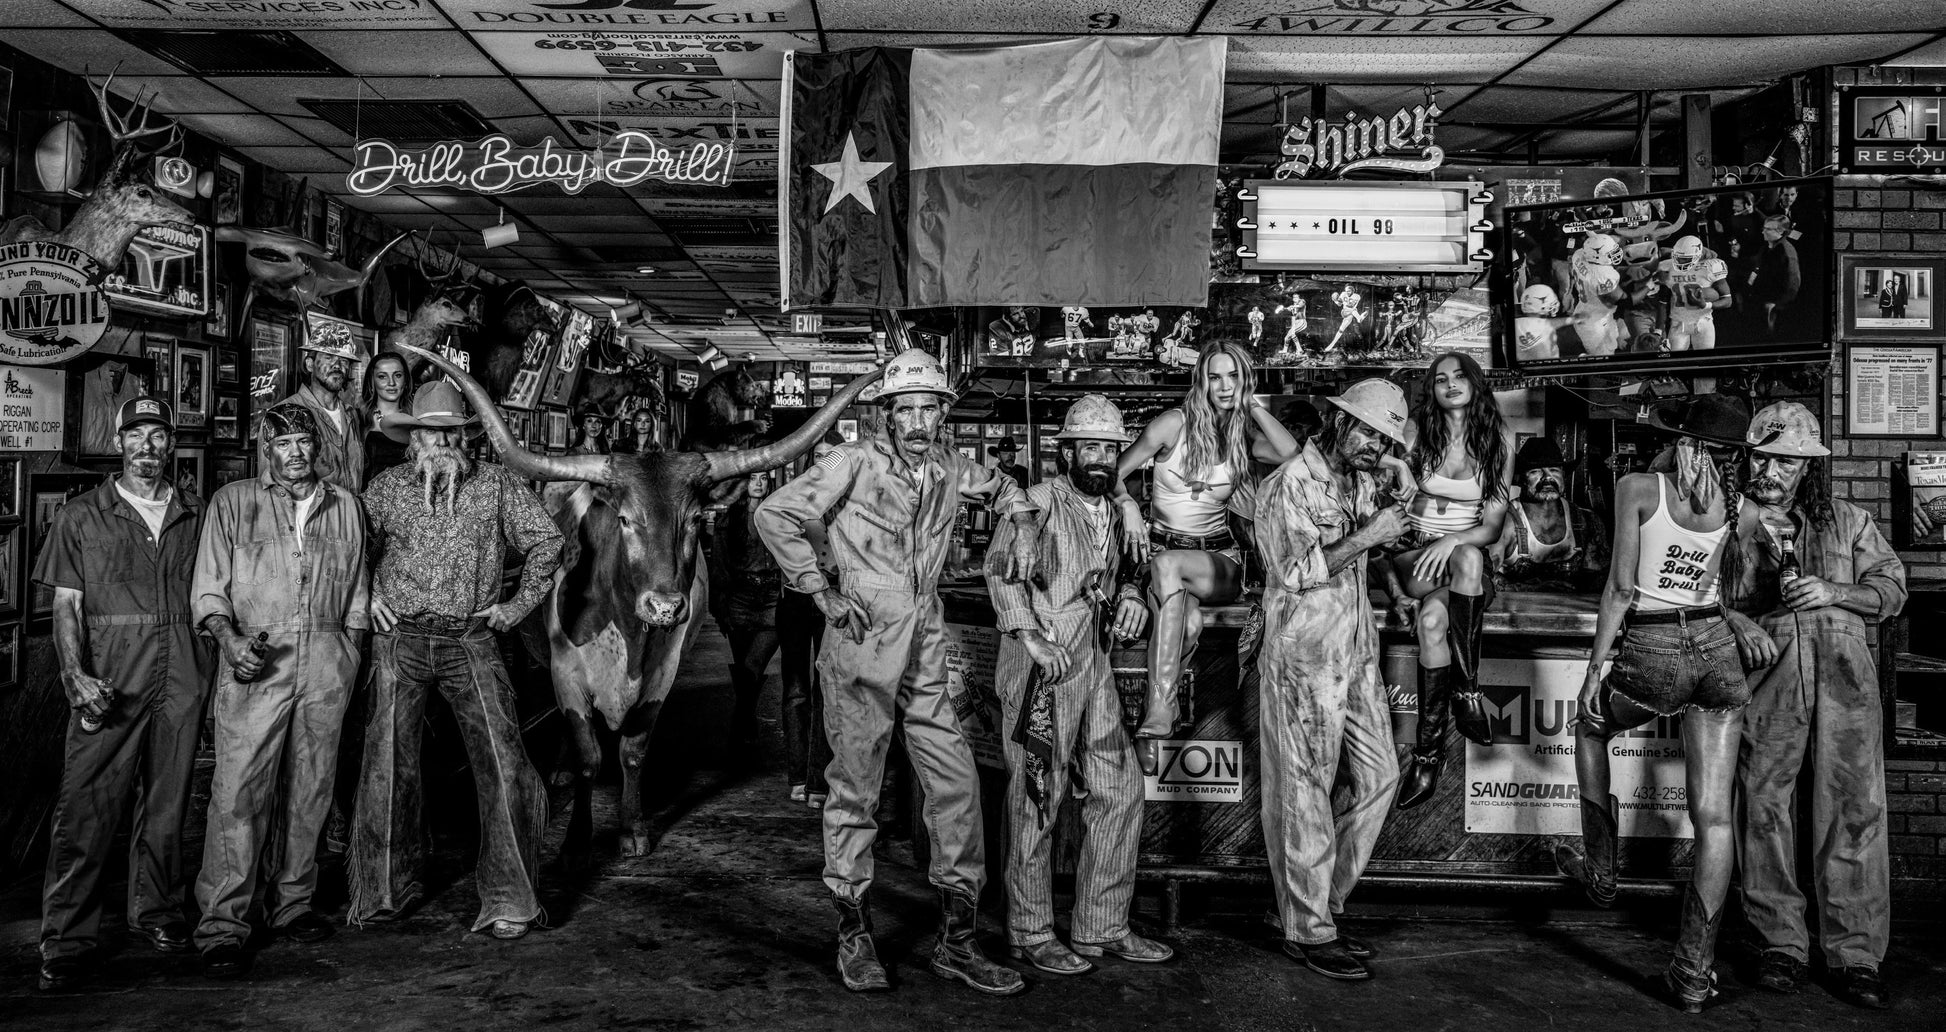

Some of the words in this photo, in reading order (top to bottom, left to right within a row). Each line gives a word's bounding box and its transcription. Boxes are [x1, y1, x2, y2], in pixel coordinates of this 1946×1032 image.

[186, 2, 344, 12] SERVICES
[472, 11, 650, 24] DOUBLE
[657, 11, 788, 24] EAGLE
[1232, 16, 1555, 32] 4WILLCO
[534, 39, 764, 52] 432-413-6599
[608, 100, 762, 112] SPARTAN
[1275, 102, 1443, 181] Shiner
[350, 141, 467, 193] Drill,
[605, 131, 735, 186] Drill!
[1328, 218, 1360, 234] OIL
[1373, 218, 1394, 234] 98
[35, 241, 80, 266] YOUR
[7, 269, 27, 279] Pure
[30, 266, 82, 289] Pennsylvania
[795, 314, 818, 333] EXIT
[1067, 312, 1082, 323] 67
[18, 344, 68, 357] Lubrication
[1012, 334, 1034, 356] 62
[775, 396, 803, 407] Modelo
[3, 404, 32, 417] RIGGAN
[41, 421, 62, 433] CORP.
[0, 435, 21, 448] WELL
[25, 435, 33, 448] #1
[1666, 544, 1709, 563] Drill
[1660, 560, 1706, 581] Baby
[1611, 745, 1661, 757] Genuine
[1157, 745, 1240, 785] ZON
[1156, 786, 1181, 794] MUD
[1186, 786, 1239, 795] COMPANY
[1470, 781, 1580, 800] SANDGUAR
[1632, 786, 1686, 800] 432-258
